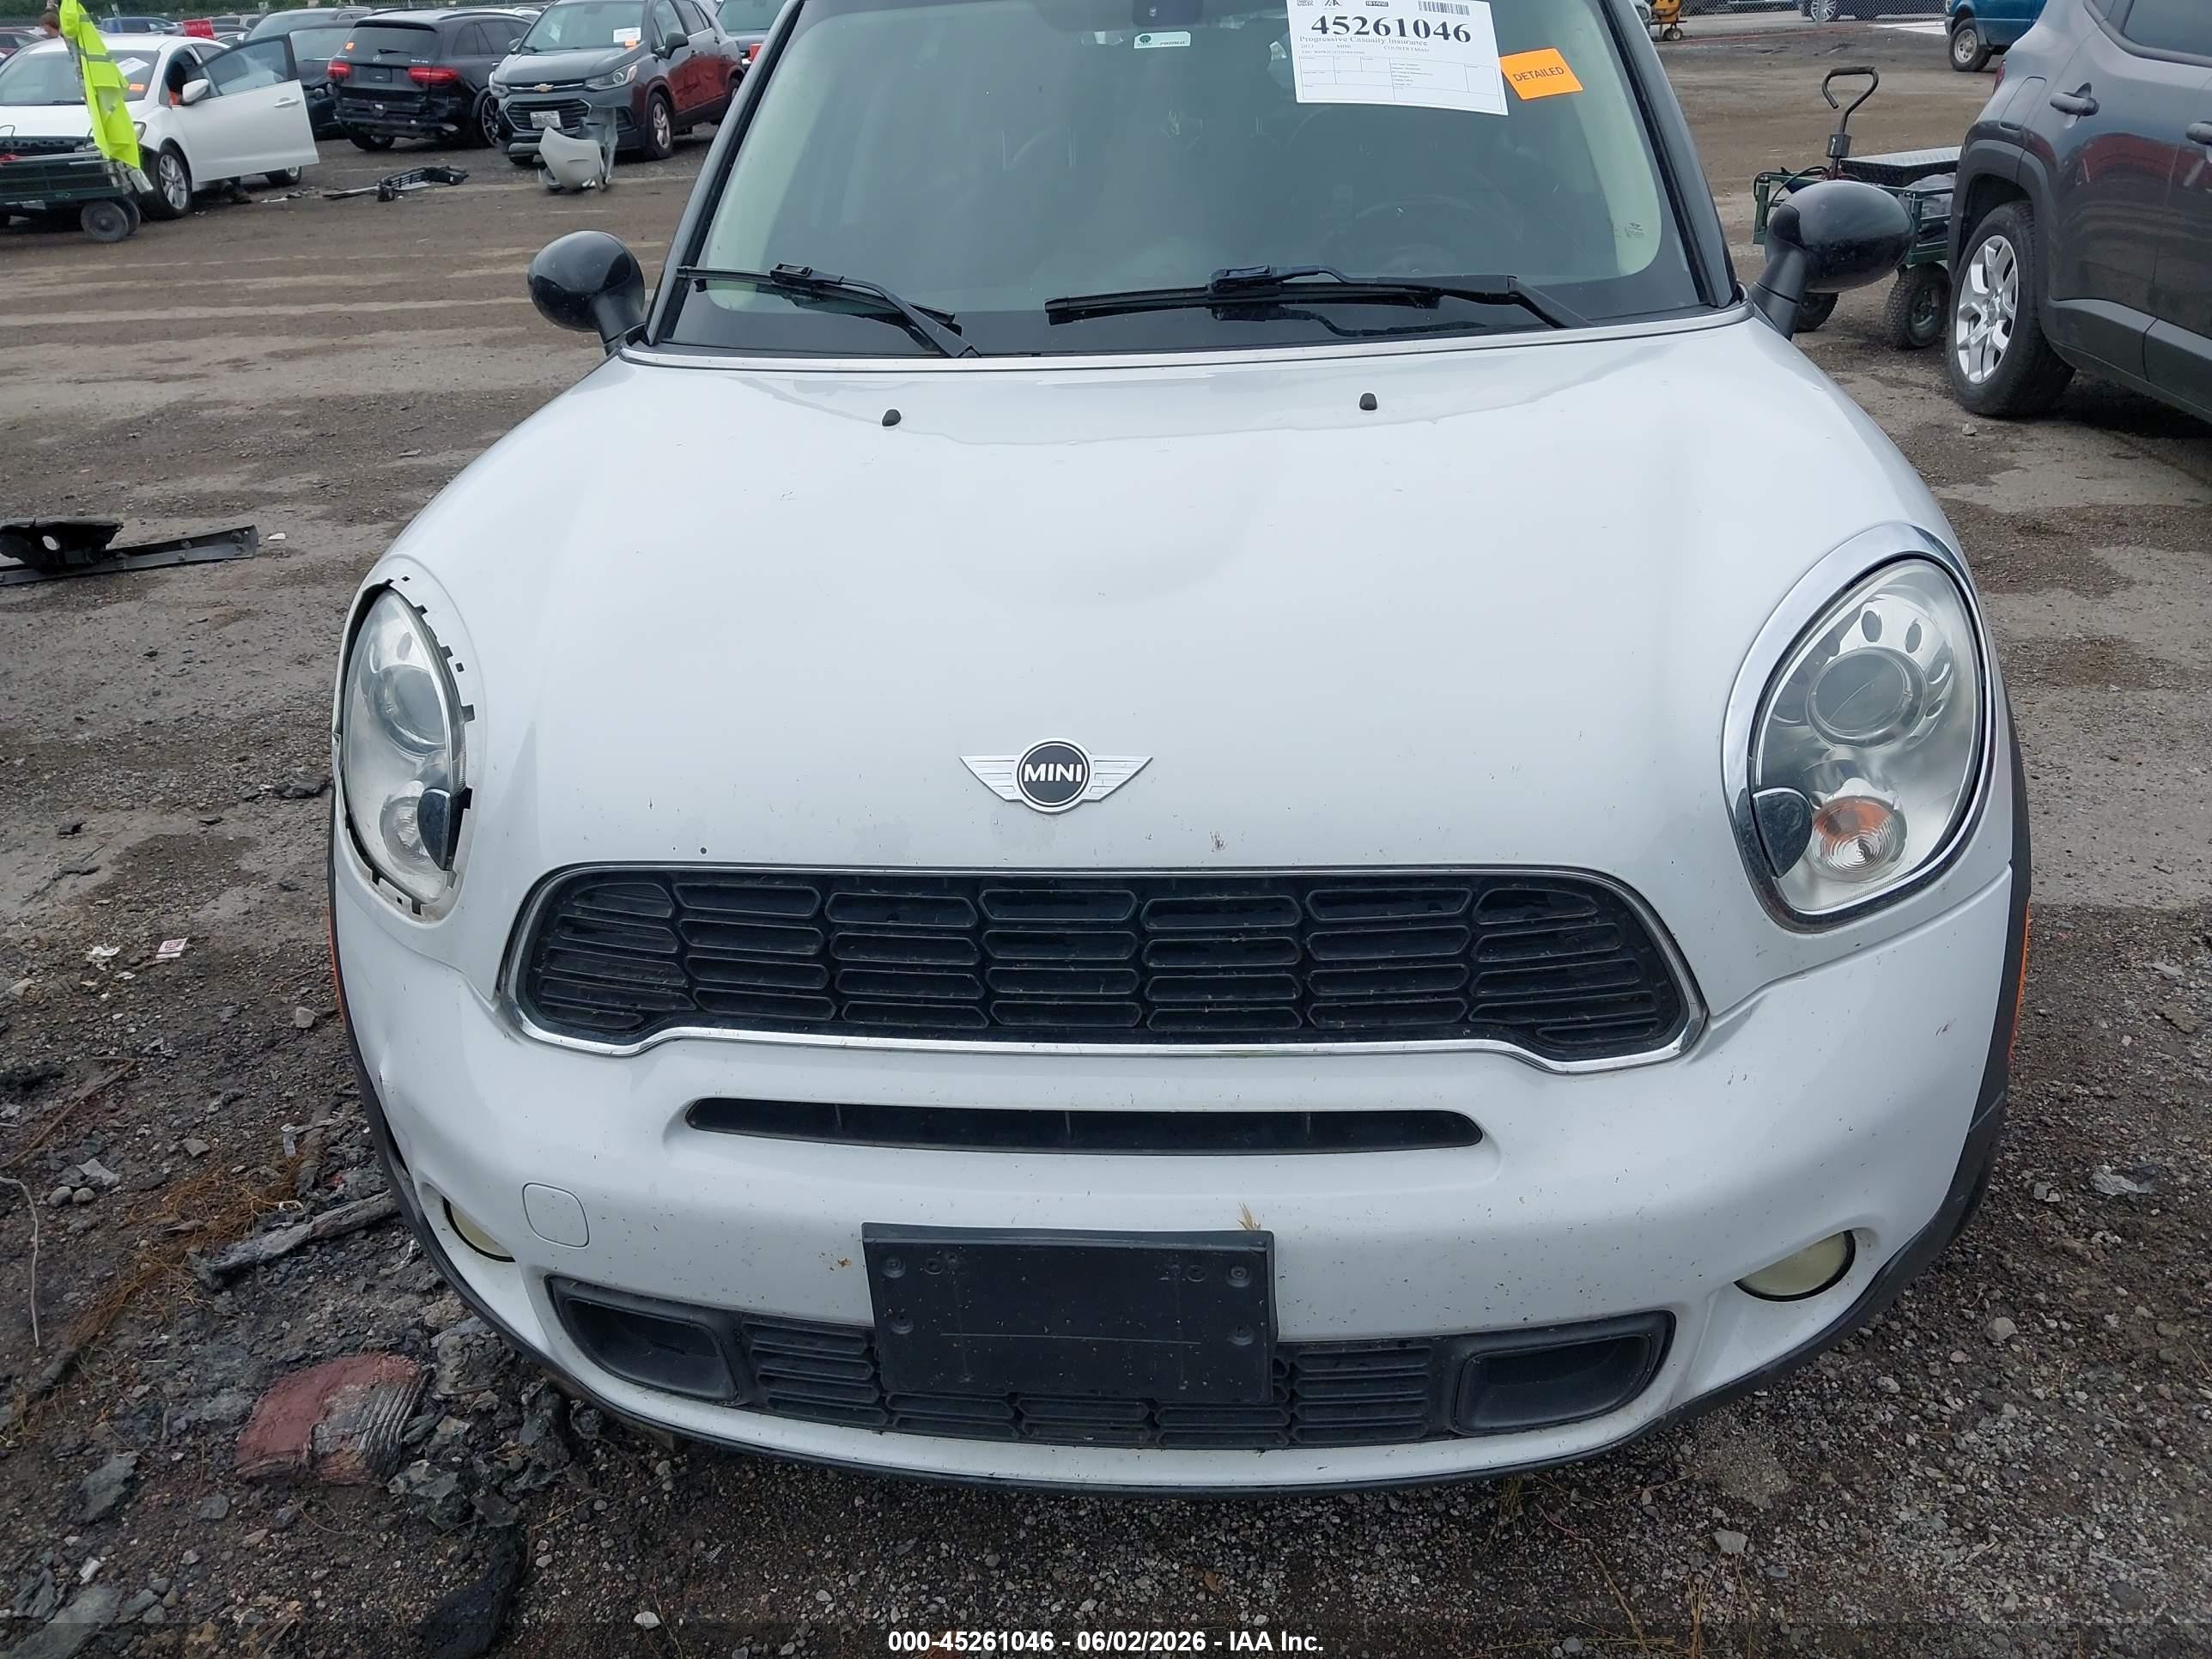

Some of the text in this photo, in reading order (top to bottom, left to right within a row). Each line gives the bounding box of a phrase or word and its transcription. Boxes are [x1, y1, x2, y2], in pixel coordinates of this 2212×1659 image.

[1311, 15, 1471, 43] 45261046
[1299, 35, 1428, 46] Progressive Casualty Insurance
[1512, 66, 1565, 82] DETAILED
[1024, 763, 1082, 782] MINI
